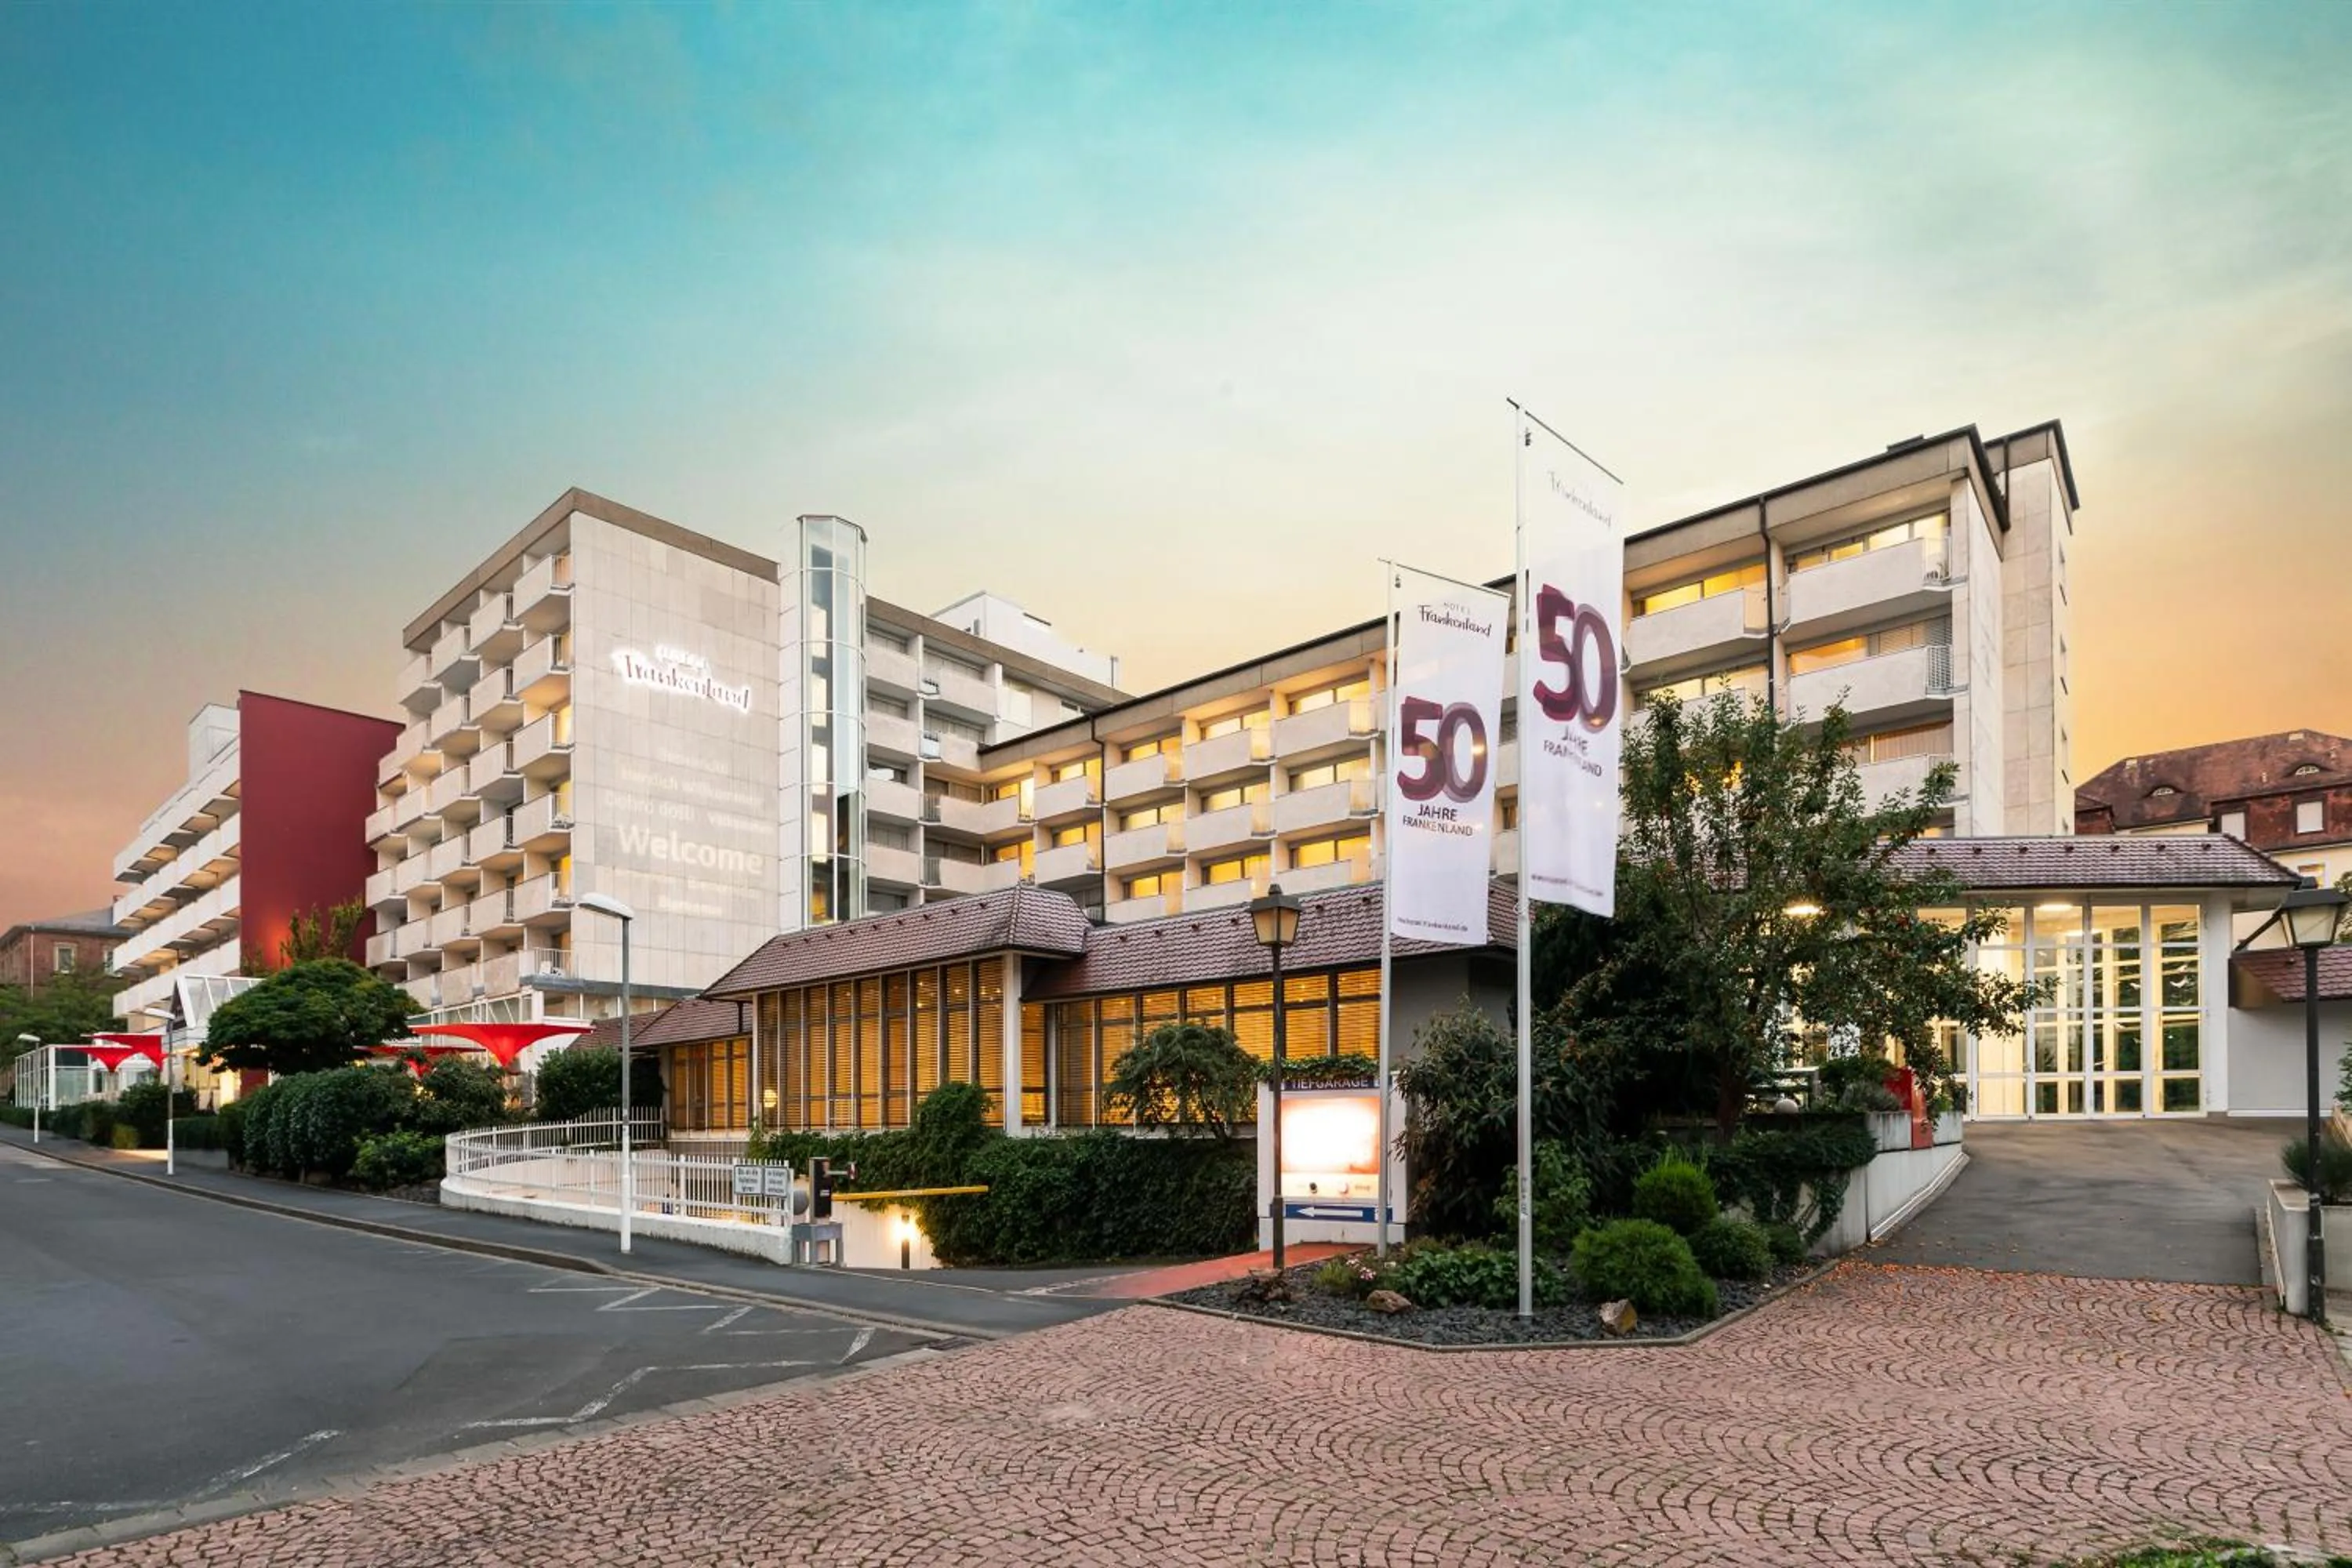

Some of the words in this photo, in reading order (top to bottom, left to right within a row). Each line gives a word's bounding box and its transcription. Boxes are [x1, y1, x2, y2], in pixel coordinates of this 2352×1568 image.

[1417, 604, 1492, 637] Frankenland
[1533, 583, 1617, 734] 50
[1396, 695, 1488, 803] 50
[1403, 815, 1473, 837] FRANKENLAND
[1417, 804, 1458, 822] JAHRE
[618, 824, 764, 874] Welcome
